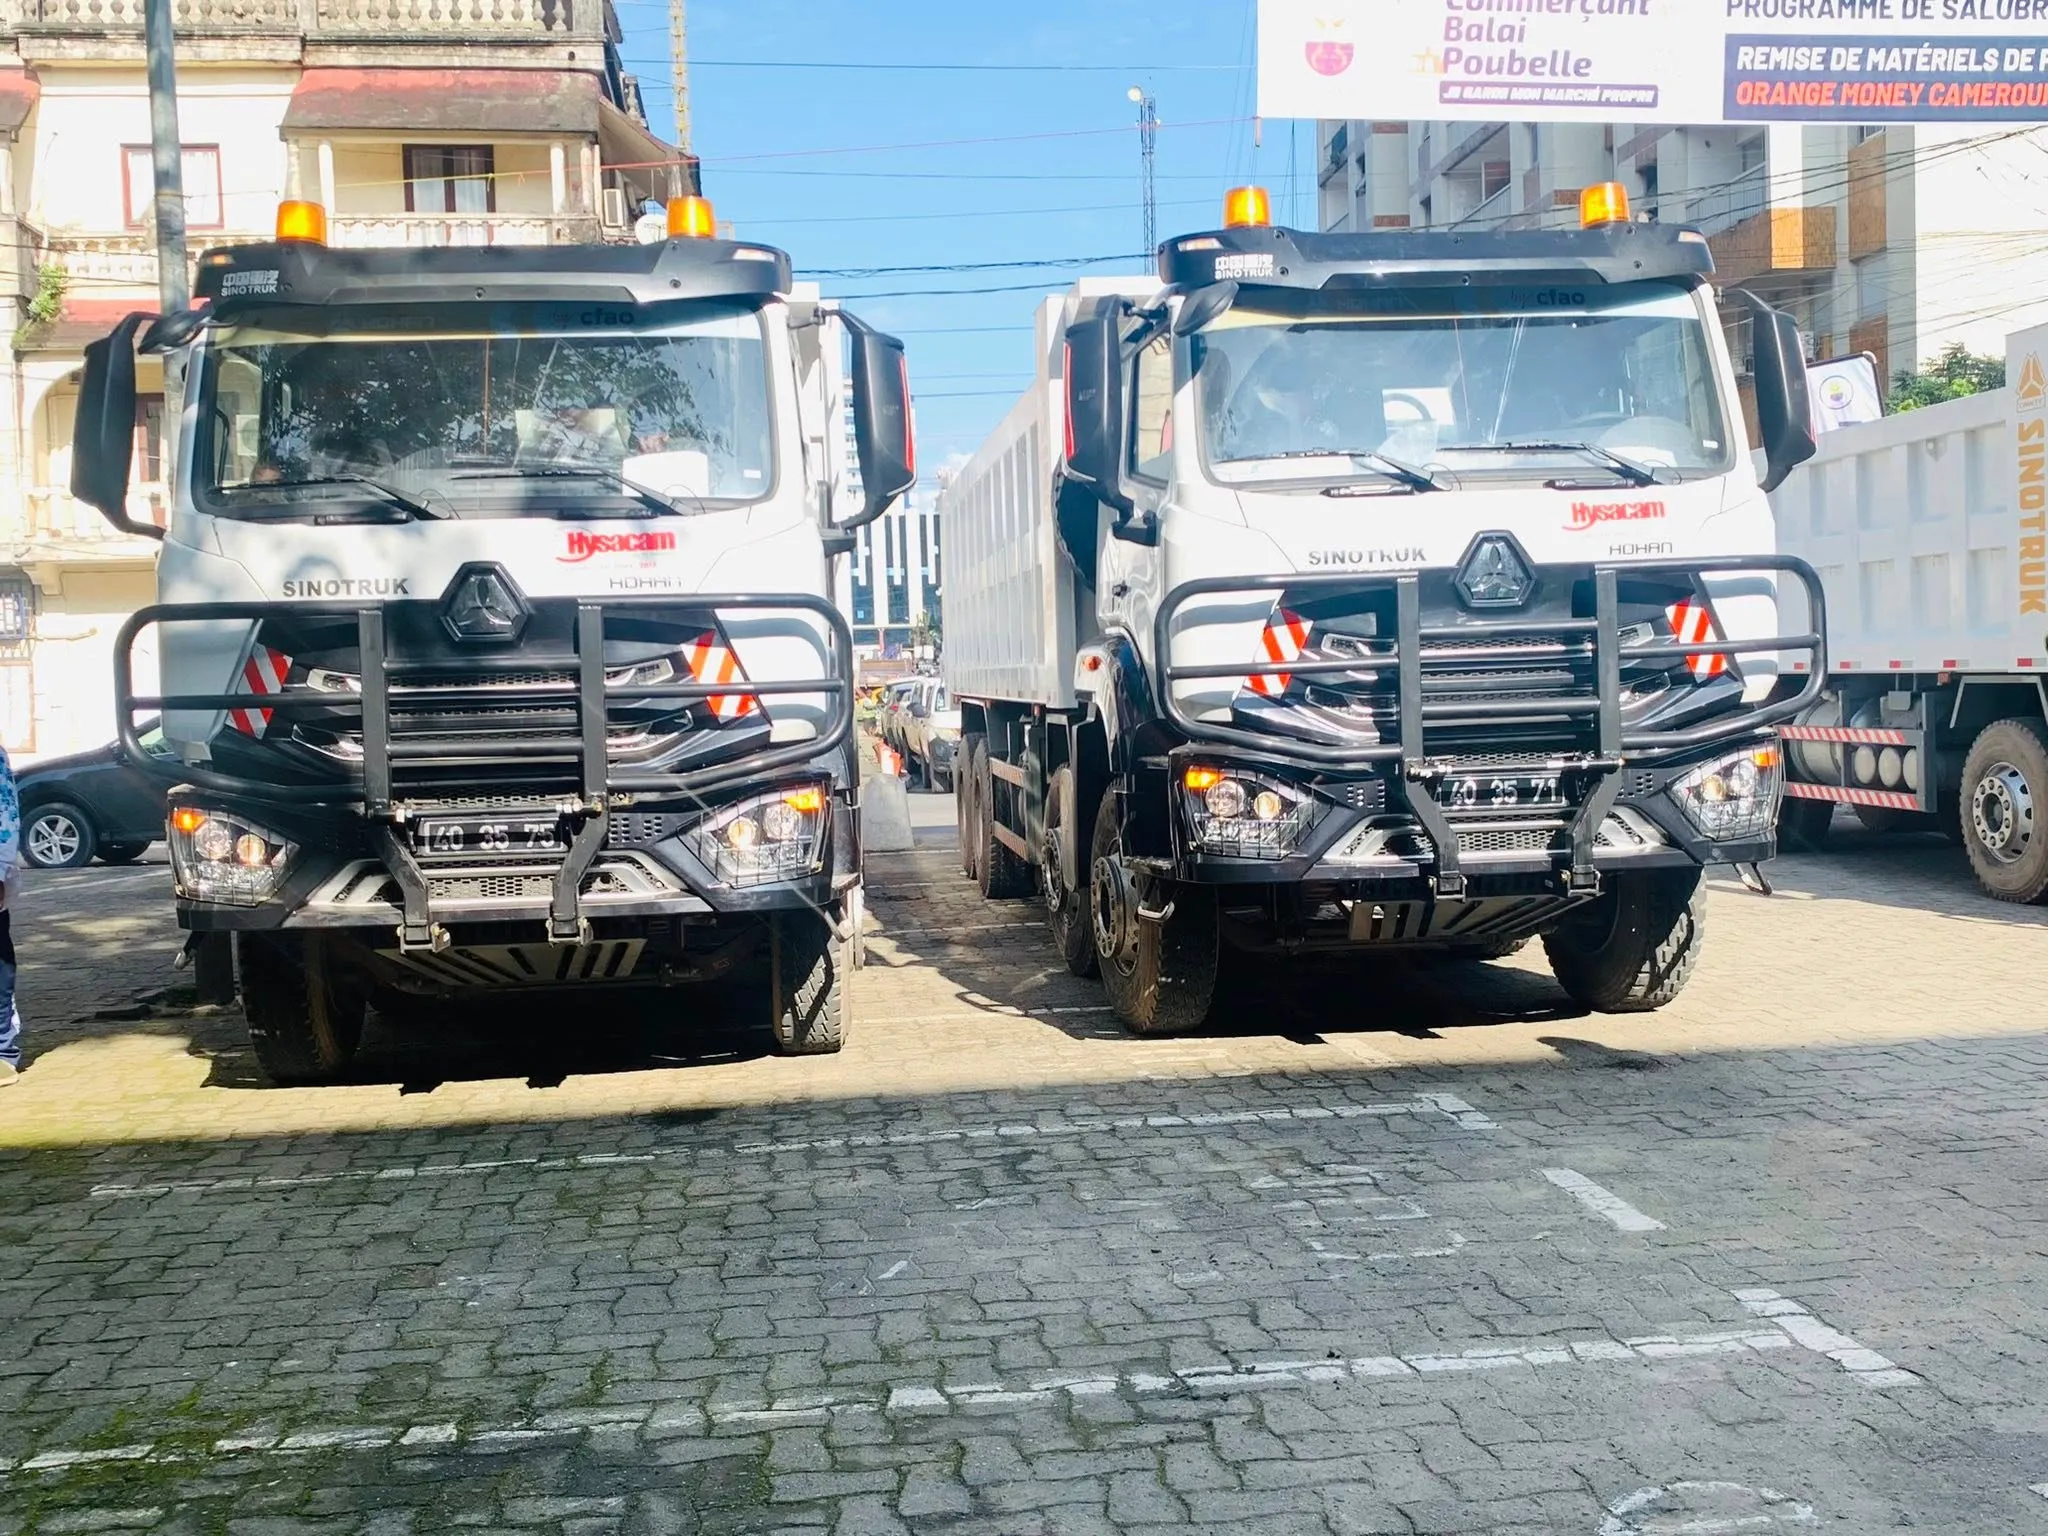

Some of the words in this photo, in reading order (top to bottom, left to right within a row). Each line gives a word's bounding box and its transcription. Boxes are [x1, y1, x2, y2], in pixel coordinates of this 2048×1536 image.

[1726, 0, 1895, 20] PROGRAMME
[1901, 0, 1935, 20] DE
[1443, 16, 1527, 43] Balai
[1442, 47, 1593, 77] Poubelle
[1737, 46, 1827, 71] REMISE
[1830, 47, 1863, 71] DE
[1866, 42, 1999, 72] MATÉRIELS
[2003, 48, 2036, 72] DE
[1736, 81, 1838, 106] ORANGE
[1840, 83, 1925, 107] MONEY
[1214, 265, 1274, 280] SINOTRUK
[221, 284, 277, 297] SINOTRUK
[581, 307, 635, 326] cfao
[1562, 500, 1666, 531] Hysacam
[2018, 417, 2047, 615] SINOTRUK
[555, 530, 677, 563] Hysacam
[1308, 547, 1427, 566] SINOTRUK
[282, 577, 409, 598] SINOTRUK
[1490, 779, 1518, 804] 35
[1530, 778, 1557, 802] 71
[523, 823, 555, 848] 75
